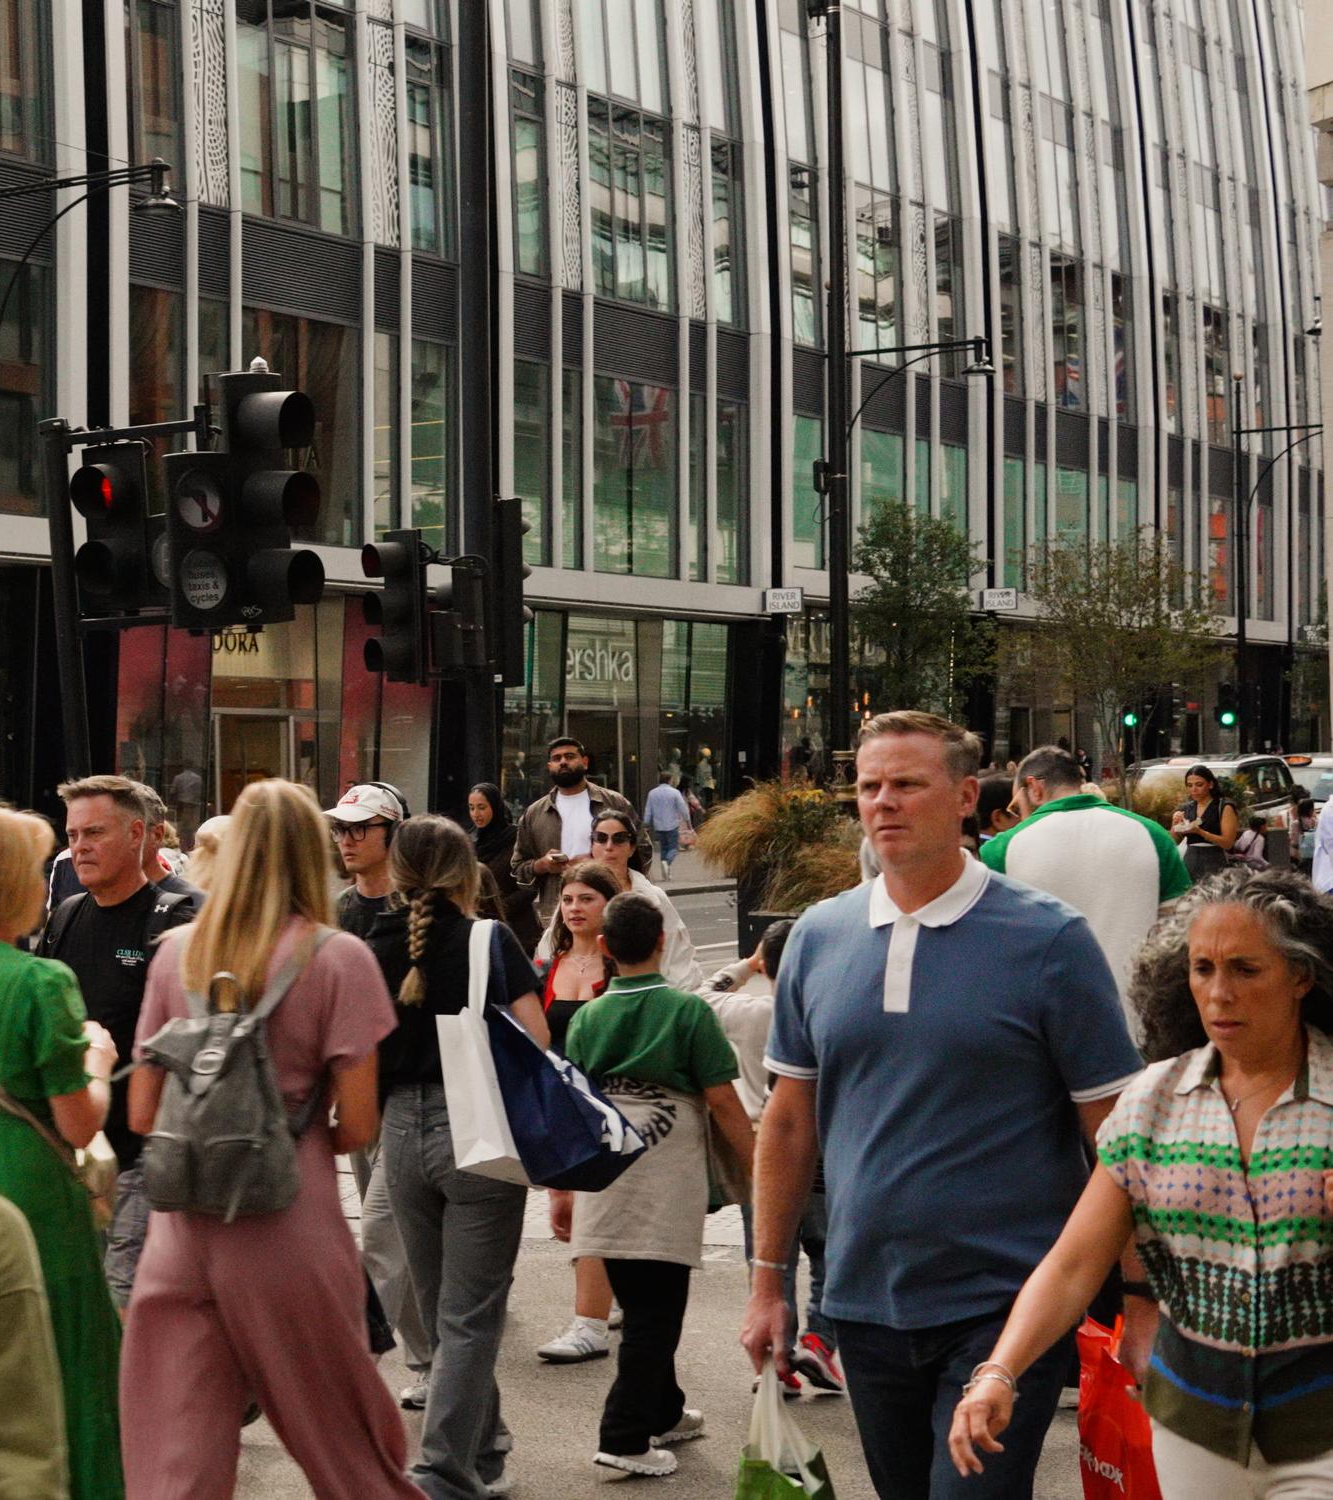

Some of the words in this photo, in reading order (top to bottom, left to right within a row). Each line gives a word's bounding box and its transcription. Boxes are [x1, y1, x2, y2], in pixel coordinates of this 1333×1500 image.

[188, 581, 210, 590] taxis
[190, 593, 219, 604] cycles
[772, 592, 796, 600] RIVER
[770, 601, 800, 609] ISLAND
